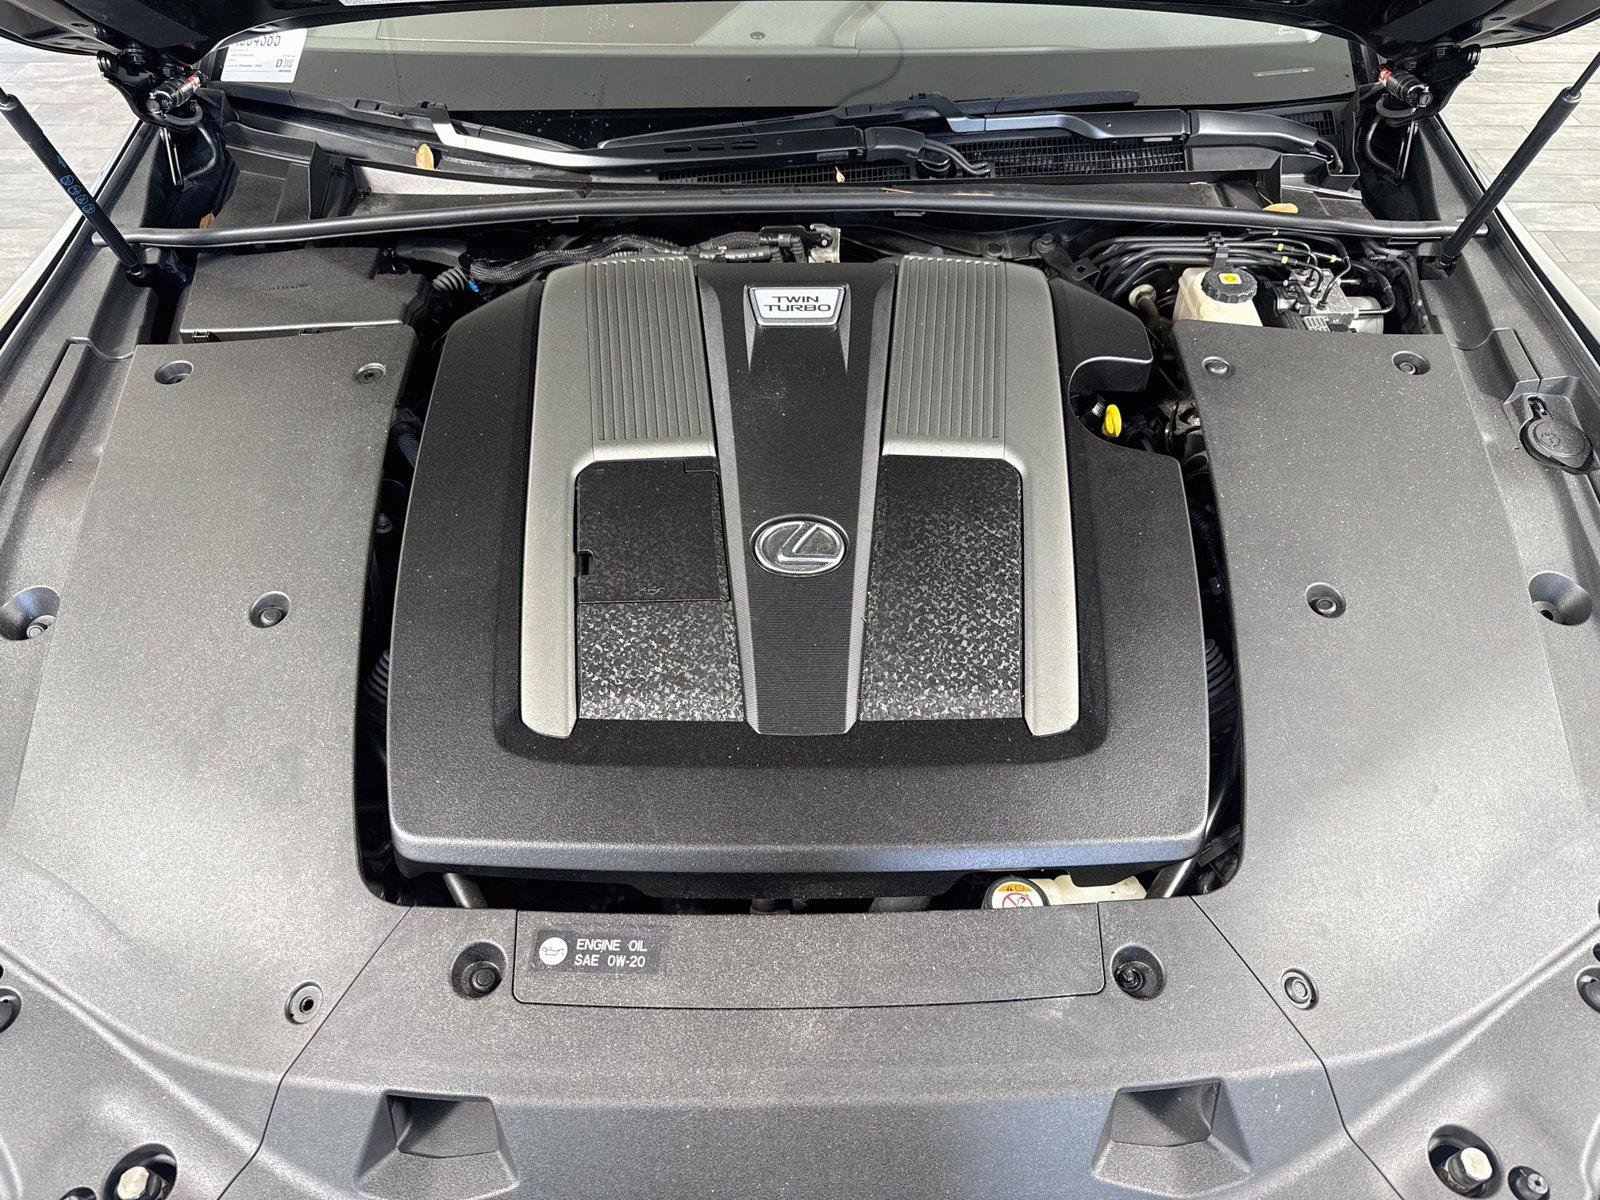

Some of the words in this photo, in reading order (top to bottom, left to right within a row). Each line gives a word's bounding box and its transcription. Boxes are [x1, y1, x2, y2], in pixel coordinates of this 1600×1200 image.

[772, 295, 819, 304] TWIN
[764, 304, 832, 312] TURBO
[576, 938, 622, 951] ENGINE
[628, 939, 648, 952] OIL
[574, 954, 600, 967] SAE
[607, 955, 647, 968] 0W-20
